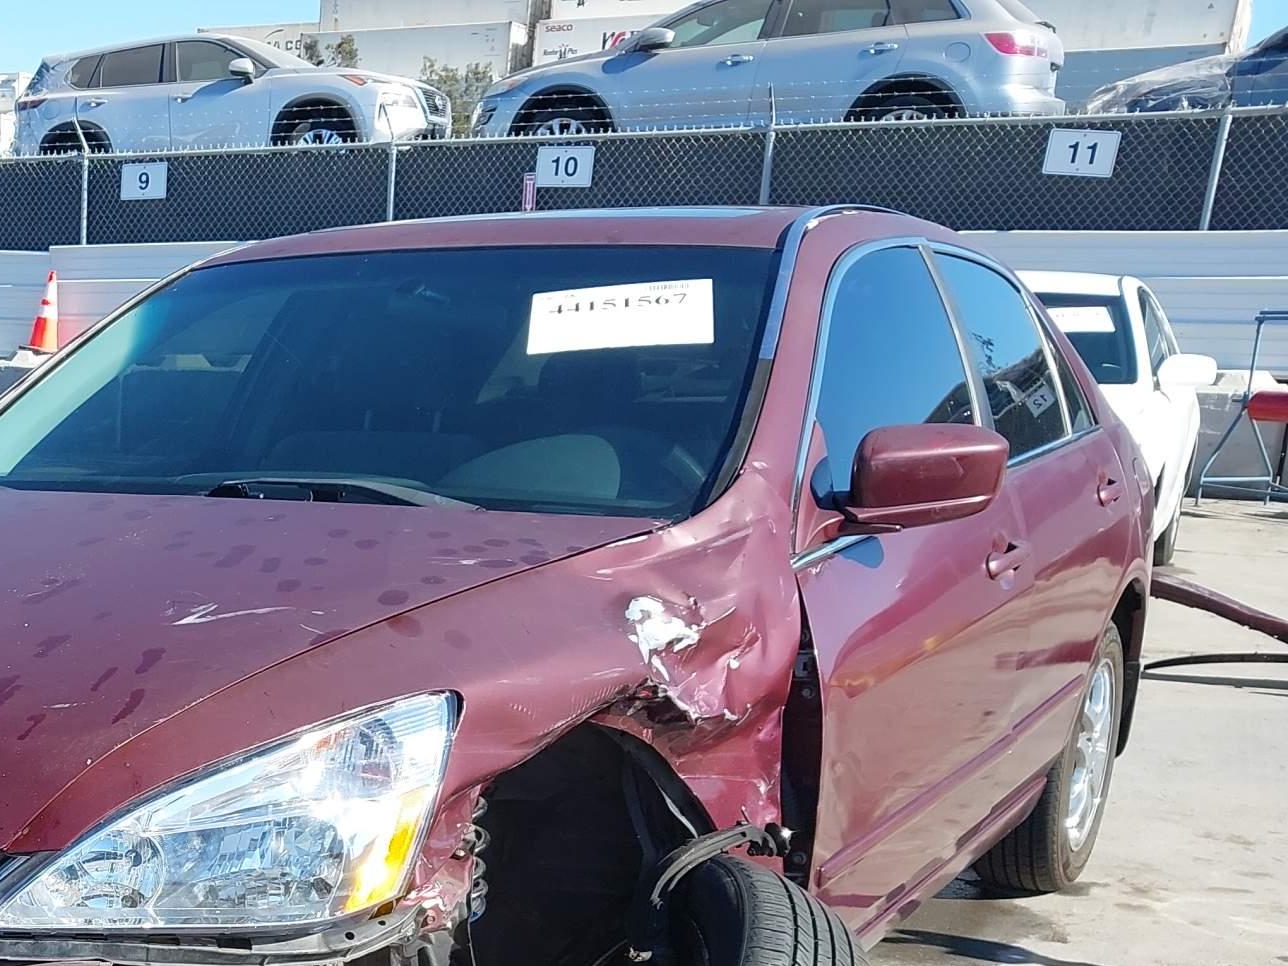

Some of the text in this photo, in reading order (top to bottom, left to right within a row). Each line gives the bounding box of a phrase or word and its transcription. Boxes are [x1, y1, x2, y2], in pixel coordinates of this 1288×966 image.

[545, 24, 573, 32] seaco
[1068, 141, 1098, 165] 11
[551, 156, 578, 177] 10
[138, 172, 149, 190] 9
[549, 292, 687, 314] 44151567
